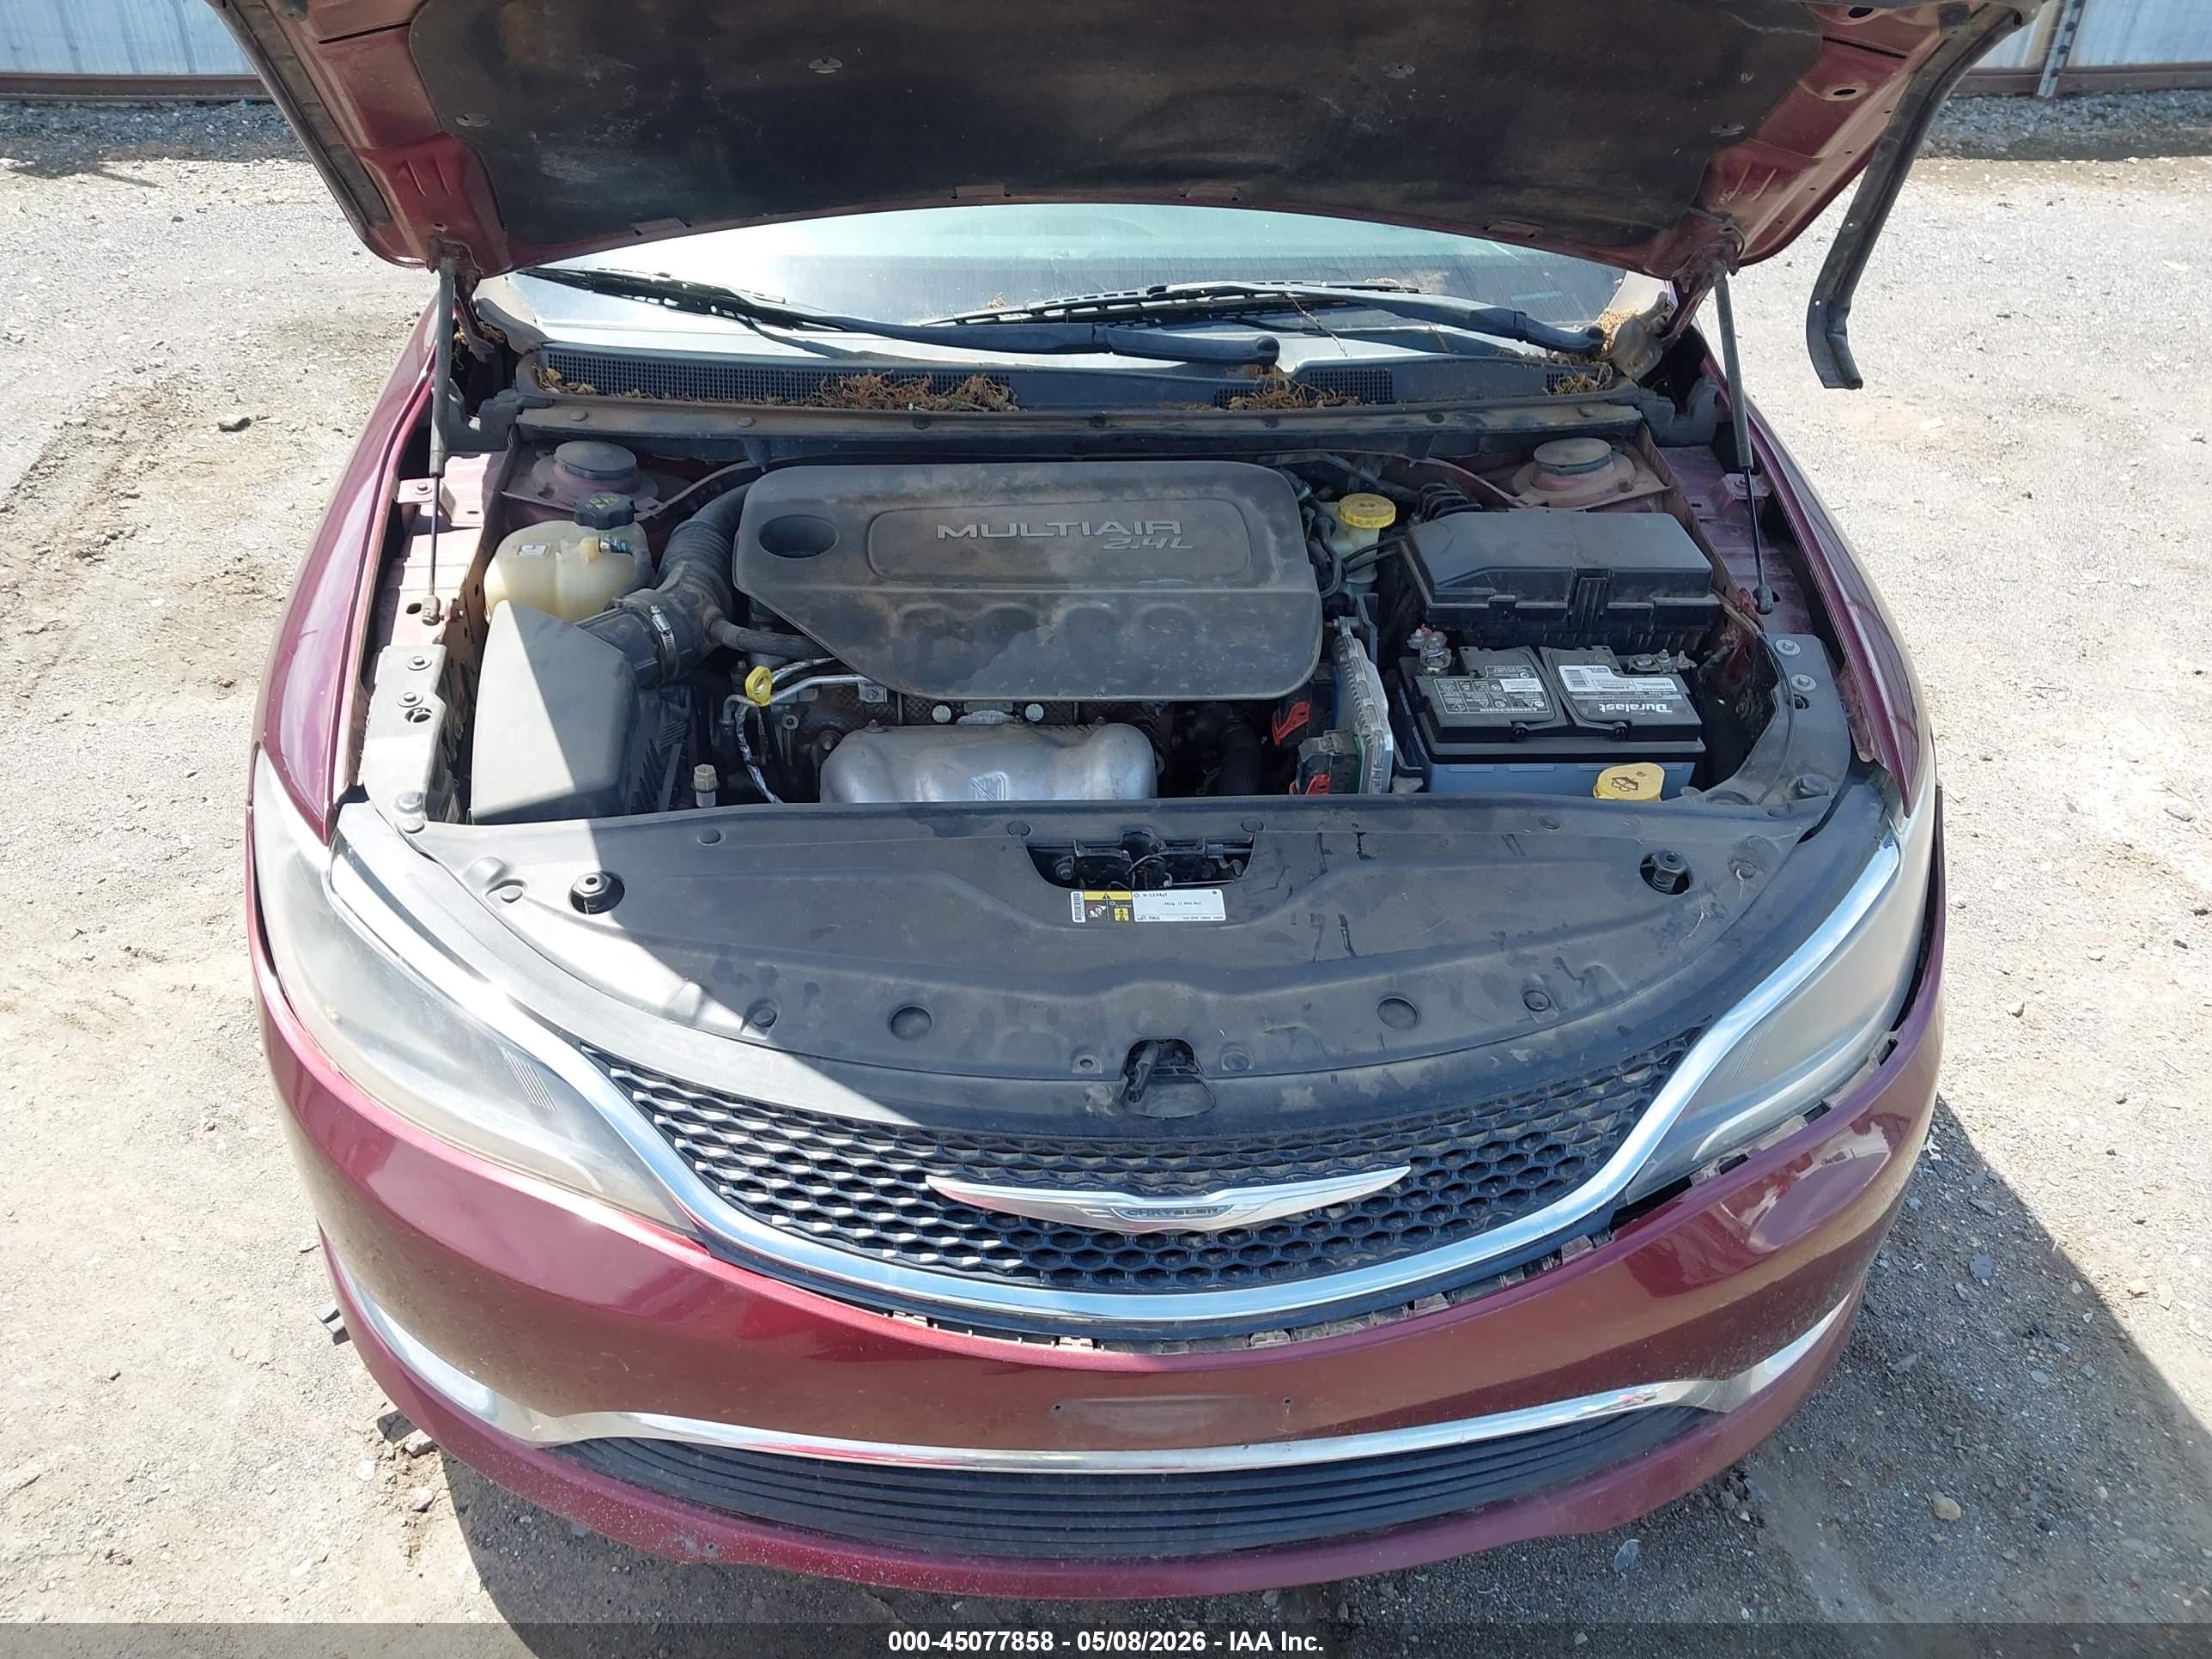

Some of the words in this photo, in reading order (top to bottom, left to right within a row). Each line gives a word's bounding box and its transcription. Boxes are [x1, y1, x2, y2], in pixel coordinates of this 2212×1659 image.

[937, 520, 1182, 539] MULTIAIR
[1102, 537, 1194, 550] 2.4L
[1599, 702, 1673, 714] Duralast
[1125, 1206, 1222, 1218] CHRYSLER
